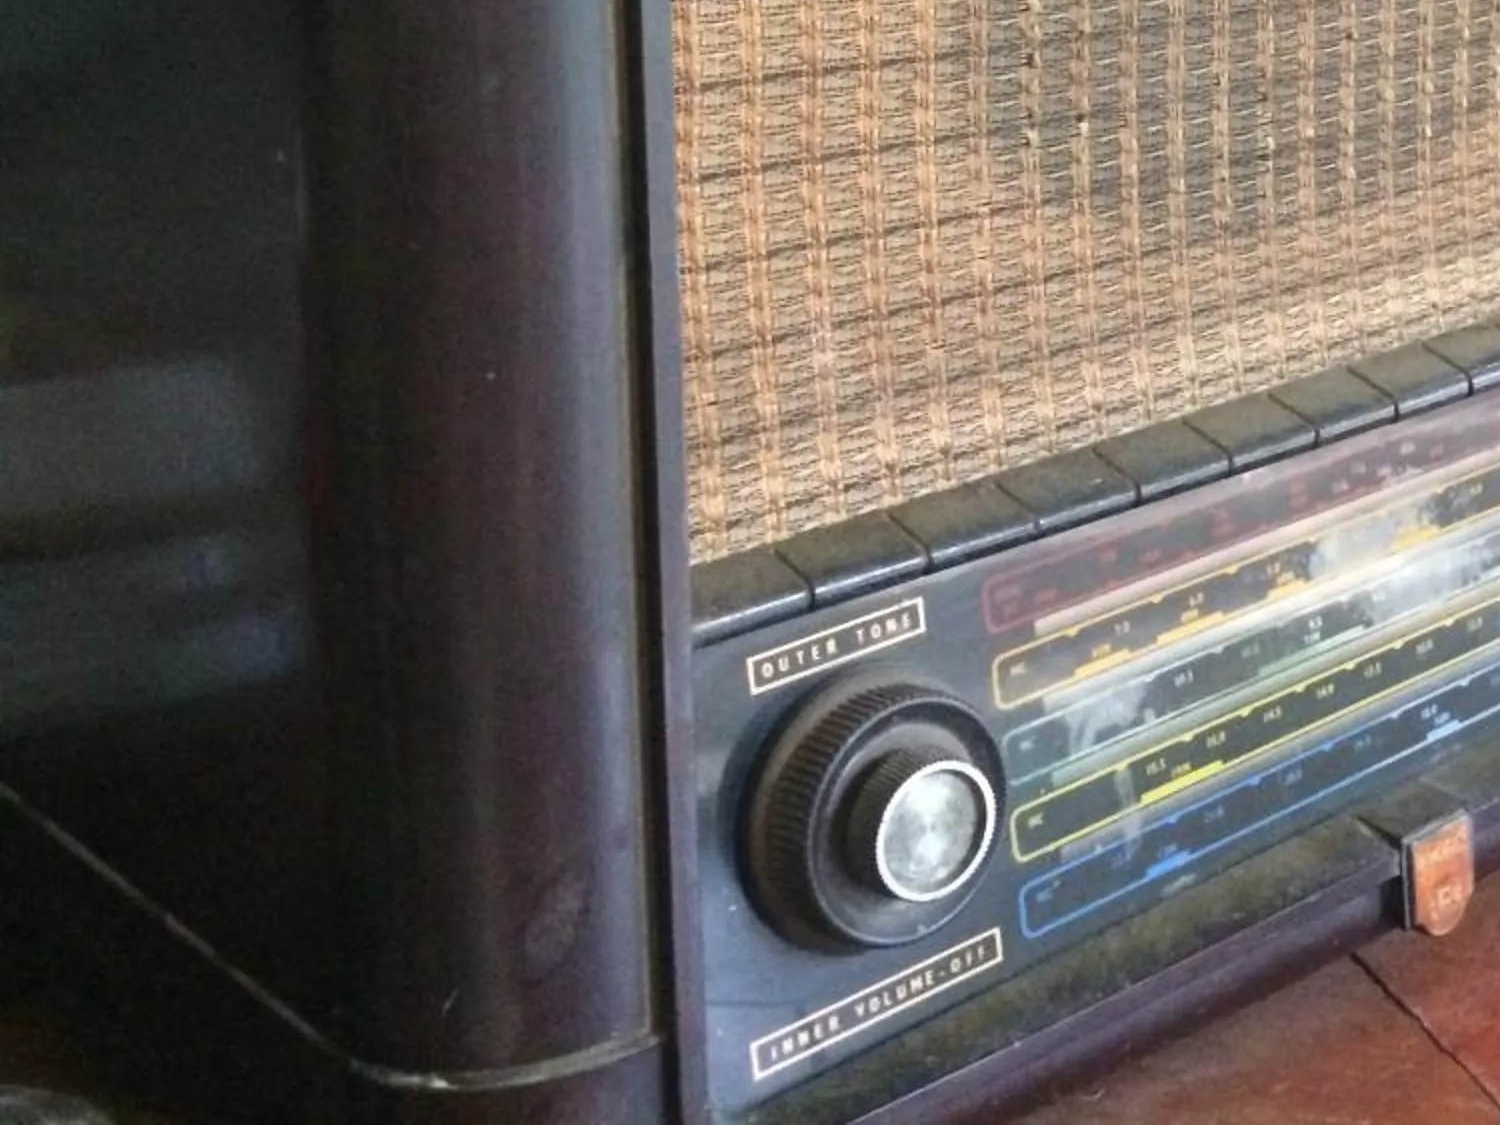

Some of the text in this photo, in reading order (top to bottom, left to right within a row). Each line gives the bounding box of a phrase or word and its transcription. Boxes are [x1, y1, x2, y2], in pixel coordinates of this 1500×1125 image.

[761, 613, 911, 678] OUTER TONE
[770, 1015, 840, 1061] INNER
